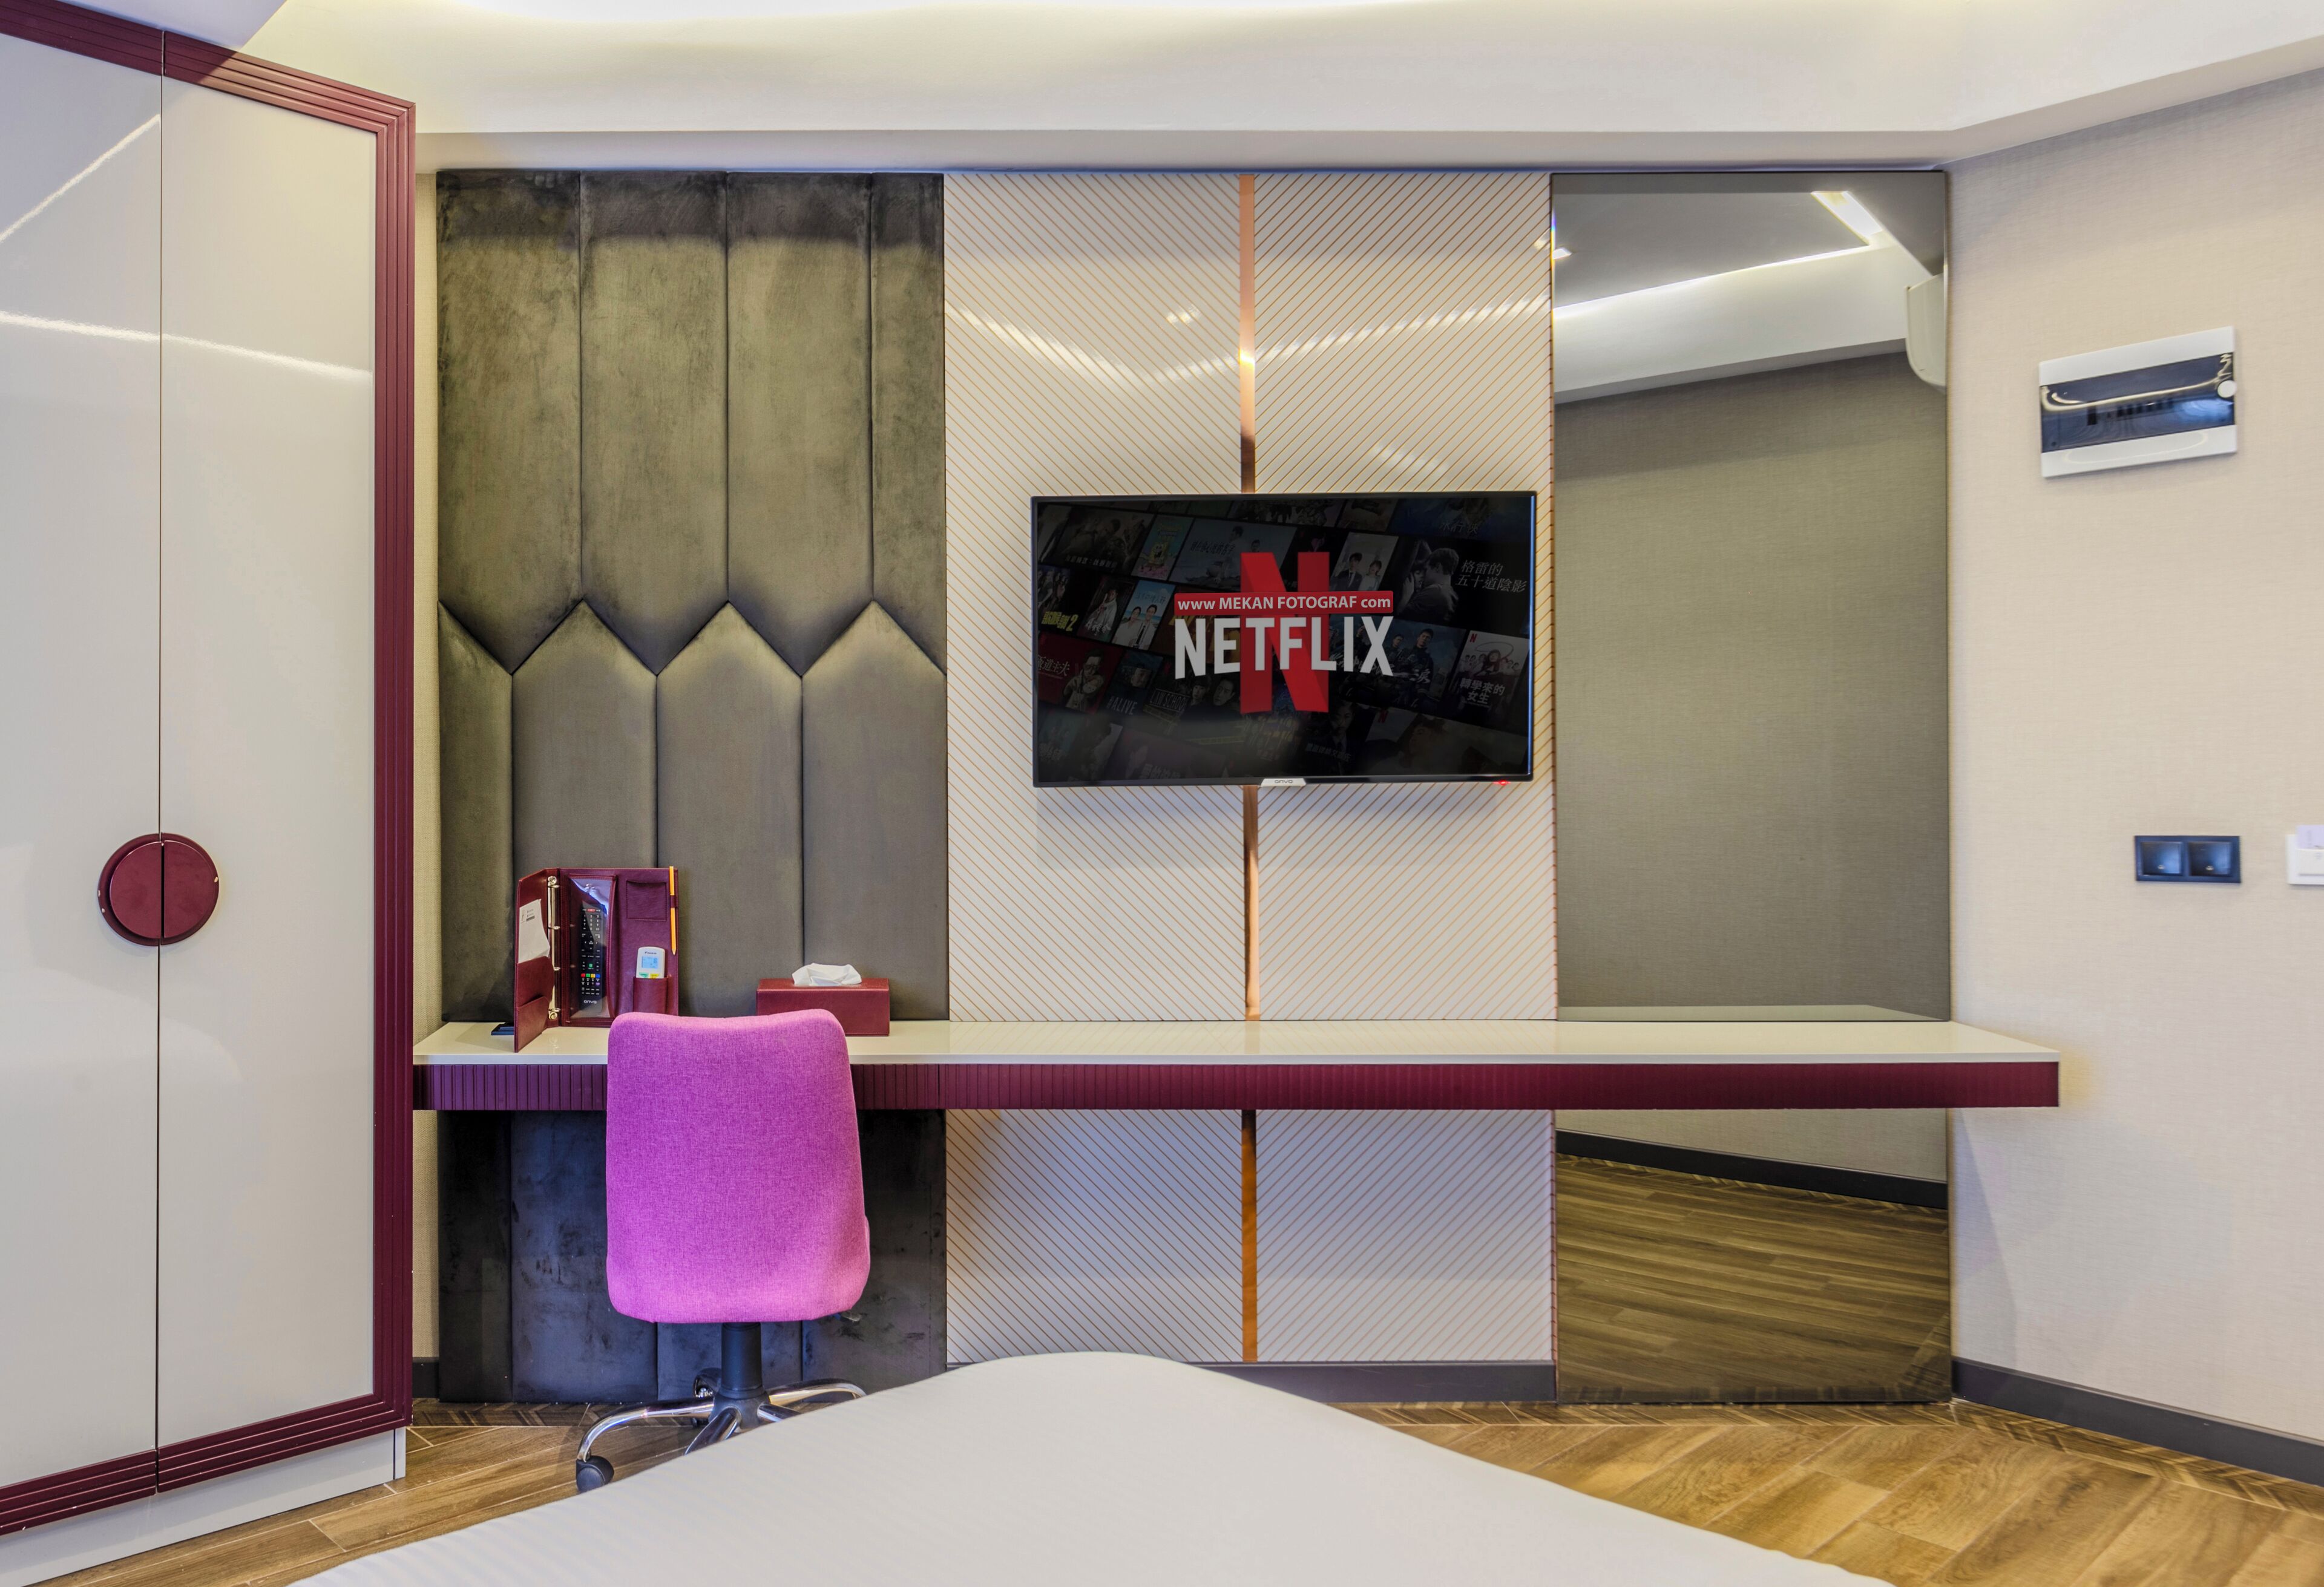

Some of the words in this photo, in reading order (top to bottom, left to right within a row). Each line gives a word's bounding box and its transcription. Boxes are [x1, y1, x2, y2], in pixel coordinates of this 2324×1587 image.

[1460, 559, 1503, 577] 格雷的
[1455, 574, 1528, 593] 五十道陰影
[1175, 616, 1393, 679] NETFLIX
[1106, 695, 1138, 715] #ALIVE
[1468, 691, 1489, 704] 女生
